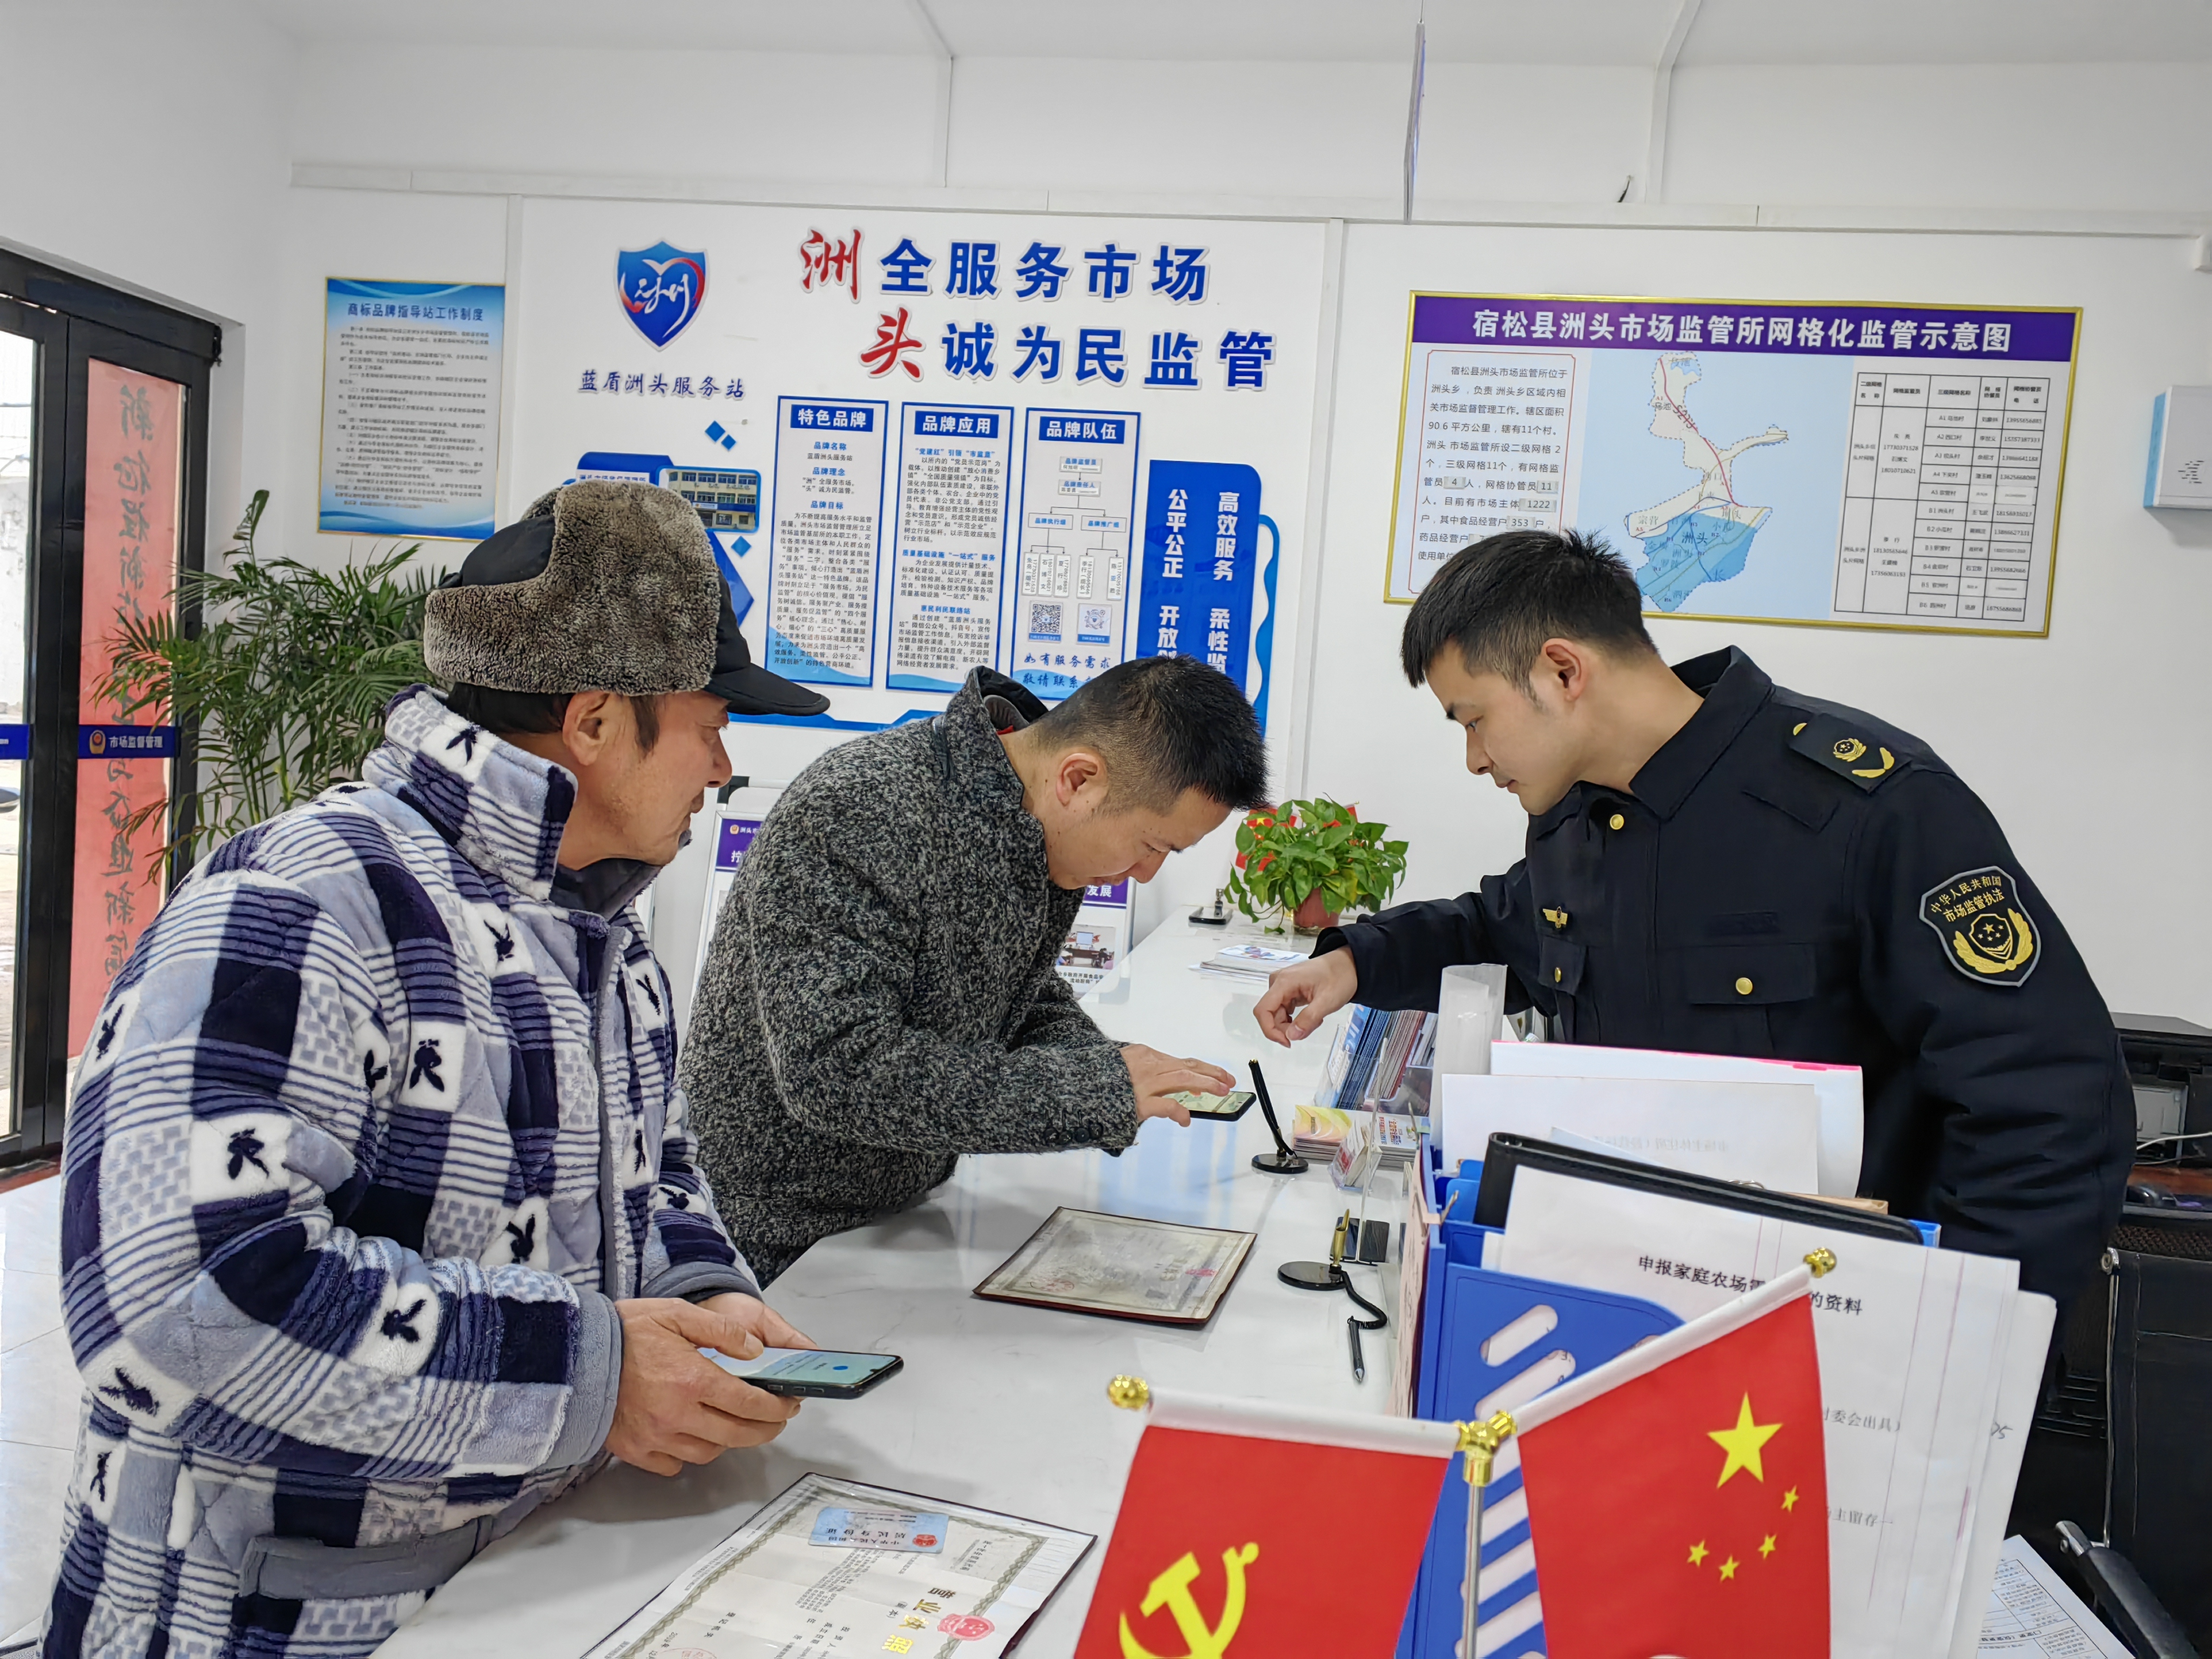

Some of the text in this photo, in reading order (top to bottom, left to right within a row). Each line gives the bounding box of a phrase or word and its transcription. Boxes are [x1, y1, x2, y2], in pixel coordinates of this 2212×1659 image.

[348, 302, 484, 321] 商标品牌指导站工作制度
[1473, 308, 2012, 353] 宿松县洲头市场监管所网格化监管示意图
[860, 307, 1275, 388] 头诚为民监管
[1451, 366, 1568, 379] 宿松县洲头市场监管所位于
[578, 369, 745, 399] 蓝盾洲头服务站
[798, 408, 866, 428] 特色品牌
[1429, 402, 1564, 417] 关市场监督管理工作。辖区面积
[922, 415, 990, 434] 品牌应用
[1047, 421, 1117, 440] 品牌队伍
[814, 442, 847, 450] 品牌名称
[807, 453, 852, 461] 蓝盾洲头服务站
[812, 467, 845, 476] 品牌理念
[811, 501, 844, 510] 品牌目标
[1162, 489, 1189, 578] 公平公正
[1213, 491, 1240, 581] 高效服务
[1682, 532, 1708, 544] 洲头
[921, 605, 970, 615] 惠民利民联络站
[1024, 653, 1111, 668] 如有服务需求
[109, 736, 163, 748] 市场监督管理
[1931, 875, 2002, 913] 中华人民共和国
[1943, 887, 2005, 922] 市场监管执法
[881, 1587, 956, 1654] 营业执照
